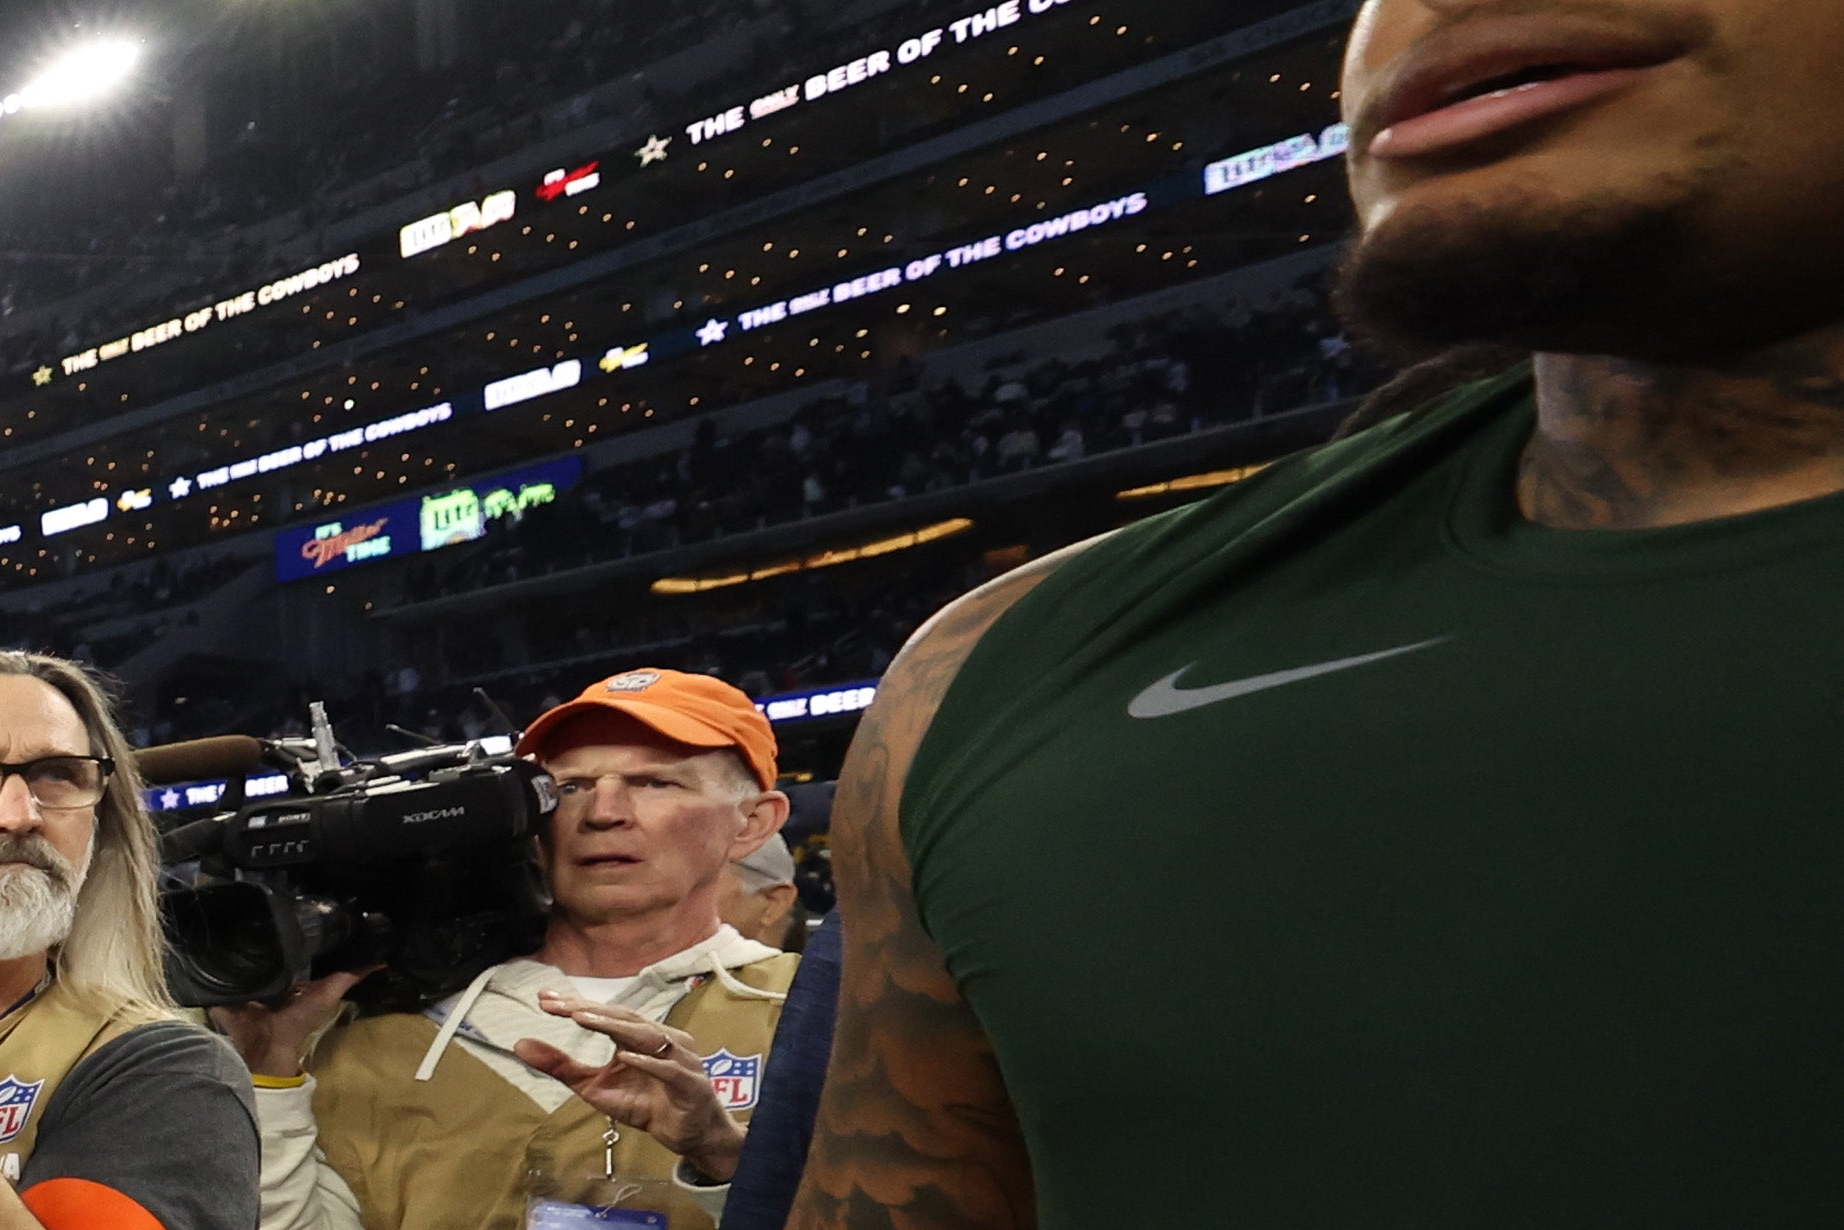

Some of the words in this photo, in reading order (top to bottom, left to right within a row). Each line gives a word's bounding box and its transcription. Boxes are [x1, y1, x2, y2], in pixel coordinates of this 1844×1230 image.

[685, 105, 745, 145] THE
[805, 50, 890, 101] BEER
[897, 28, 943, 64] OF
[948, 0, 1022, 44] THE
[737, 301, 787, 331] THE
[833, 267, 901, 303] BEER
[905, 253, 942, 281] OF
[945, 236, 1002, 268] THE
[1005, 192, 1148, 250] COWBOYS
[61, 348, 98, 375] THE
[131, 318, 182, 352] BEER
[184, 306, 213, 332] OF
[214, 291, 256, 321] THE
[257, 252, 360, 306] COWBOYS
[365, 402, 453, 442] COWBOYS
[810, 687, 876, 716] BEER
[186, 784, 218, 805] THE
[245, 775, 289, 797] BEER
[712, 1078, 748, 1103] FL
